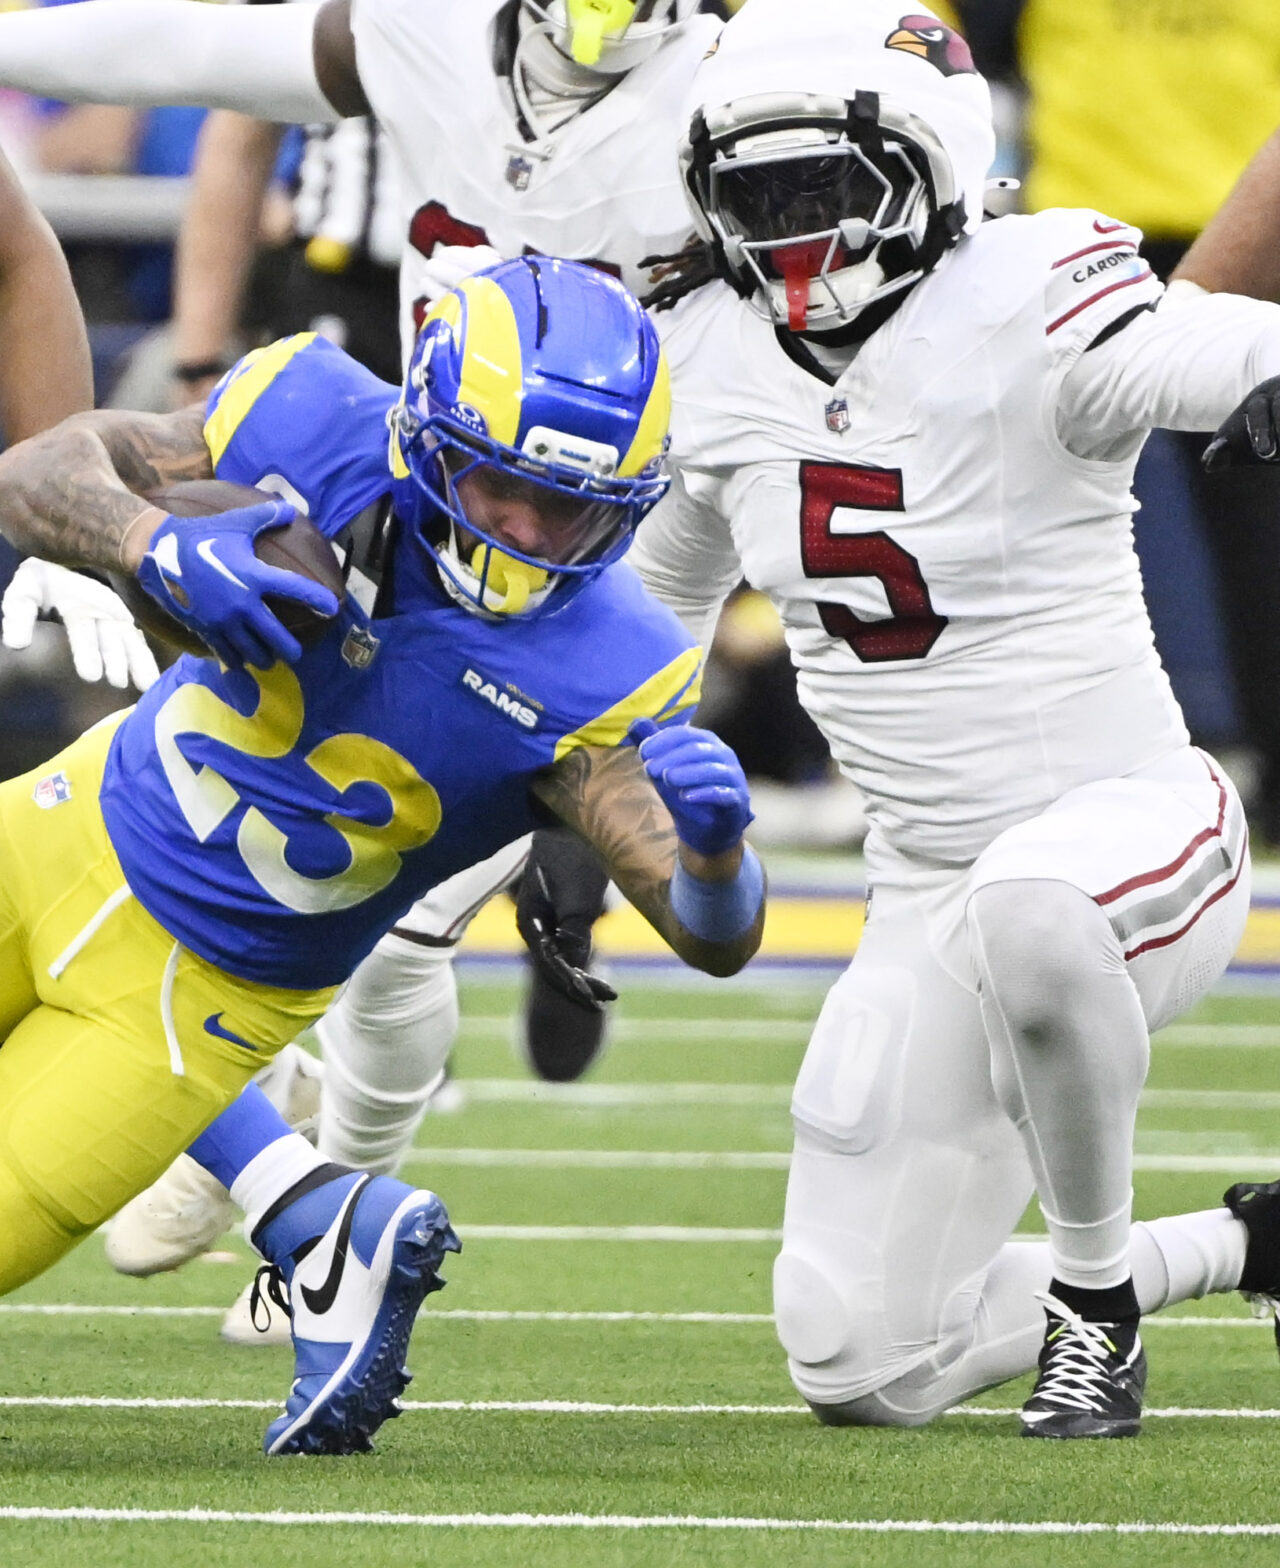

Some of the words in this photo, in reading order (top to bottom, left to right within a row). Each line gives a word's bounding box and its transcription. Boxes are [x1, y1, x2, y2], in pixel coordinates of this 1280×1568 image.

[799, 459, 949, 663] 5
[154, 656, 442, 914] 23
[462, 668, 539, 728] RAMS
